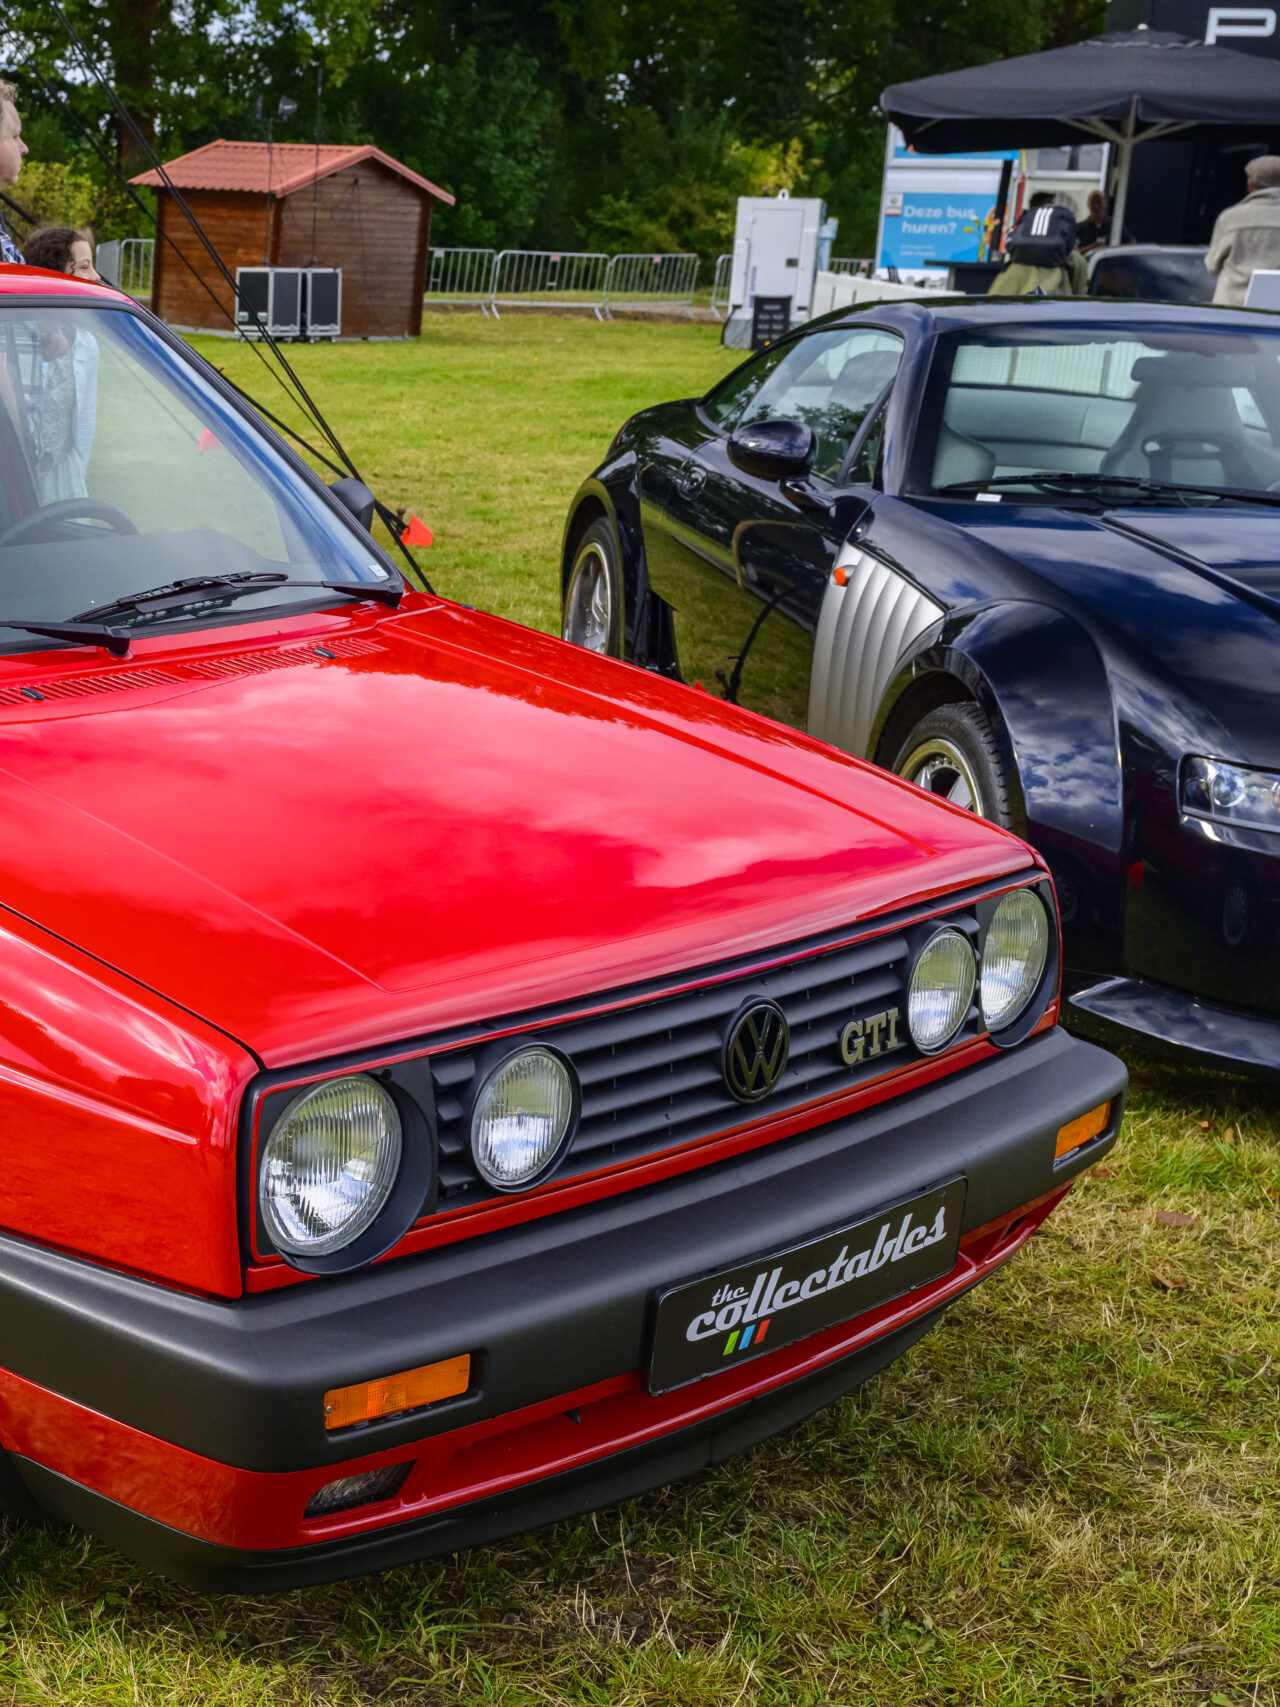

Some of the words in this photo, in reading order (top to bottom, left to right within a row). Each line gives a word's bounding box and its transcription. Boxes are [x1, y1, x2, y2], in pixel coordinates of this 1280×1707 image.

[904, 205, 943, 218] Deze
[946, 205, 976, 219] bus
[901, 221, 957, 235] huren?
[839, 1007, 899, 1065] GTI
[686, 1206, 948, 1342] collectables
[711, 1283, 750, 1307] the
